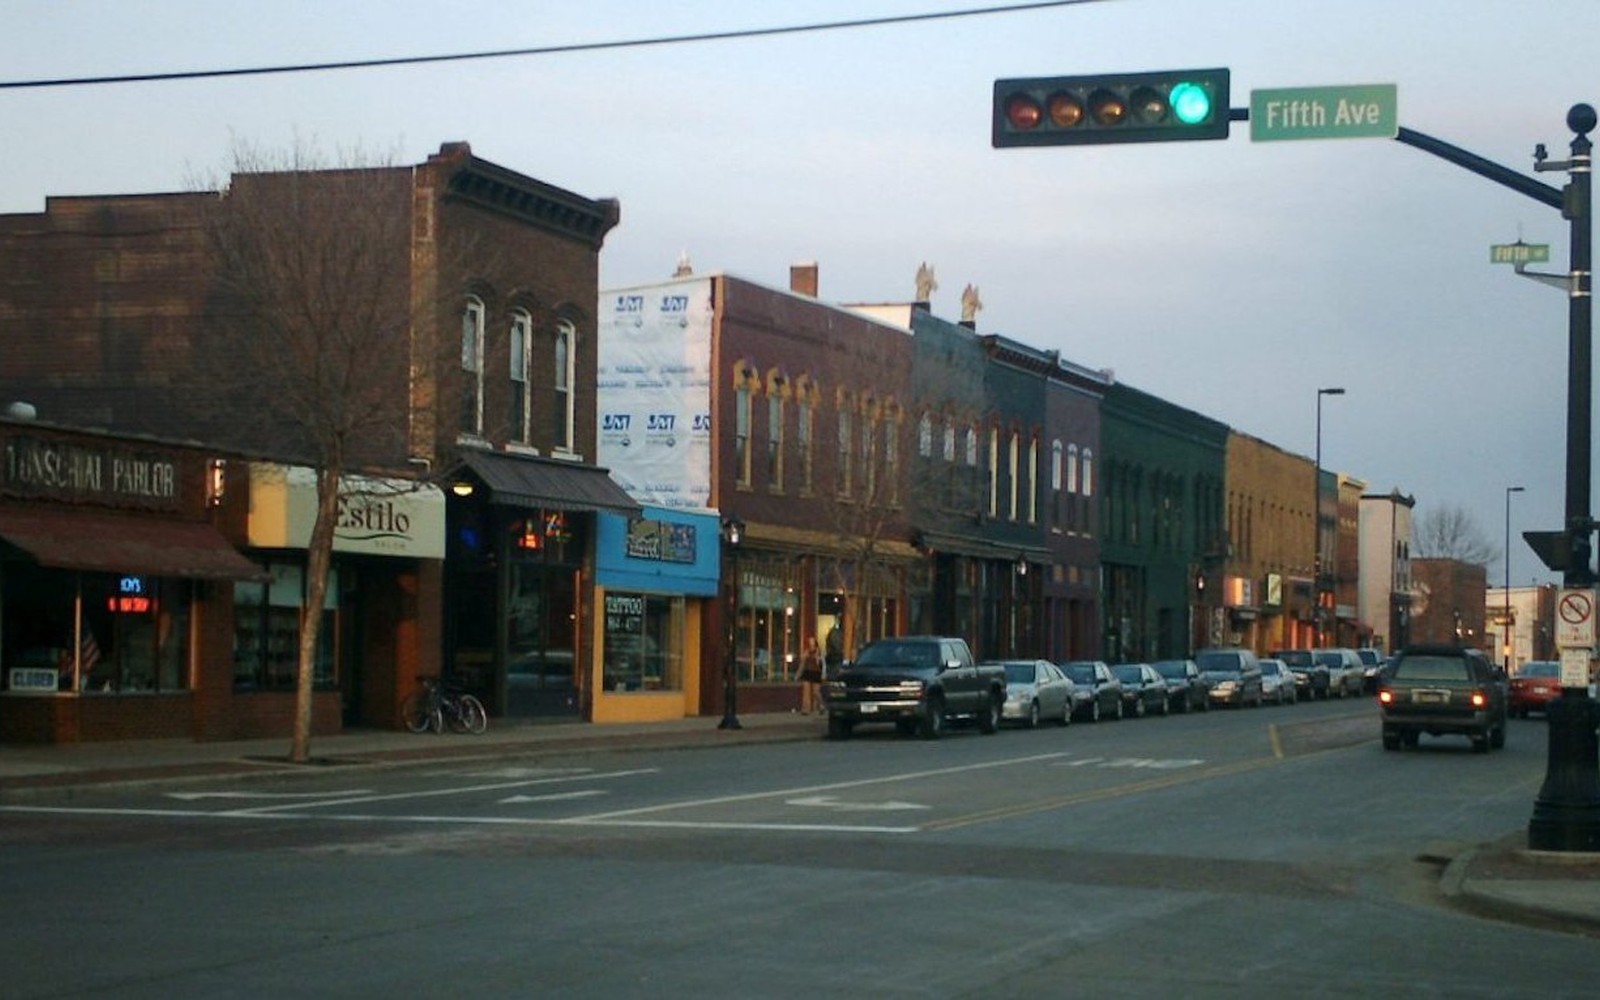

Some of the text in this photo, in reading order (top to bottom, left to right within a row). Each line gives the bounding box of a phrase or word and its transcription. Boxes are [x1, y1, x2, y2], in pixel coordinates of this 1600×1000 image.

[1266, 98, 1381, 128] Fifth Ave
[112, 457, 175, 497] PARLOR
[335, 496, 410, 533] Estilo
[605, 596, 642, 615] TATTOO
